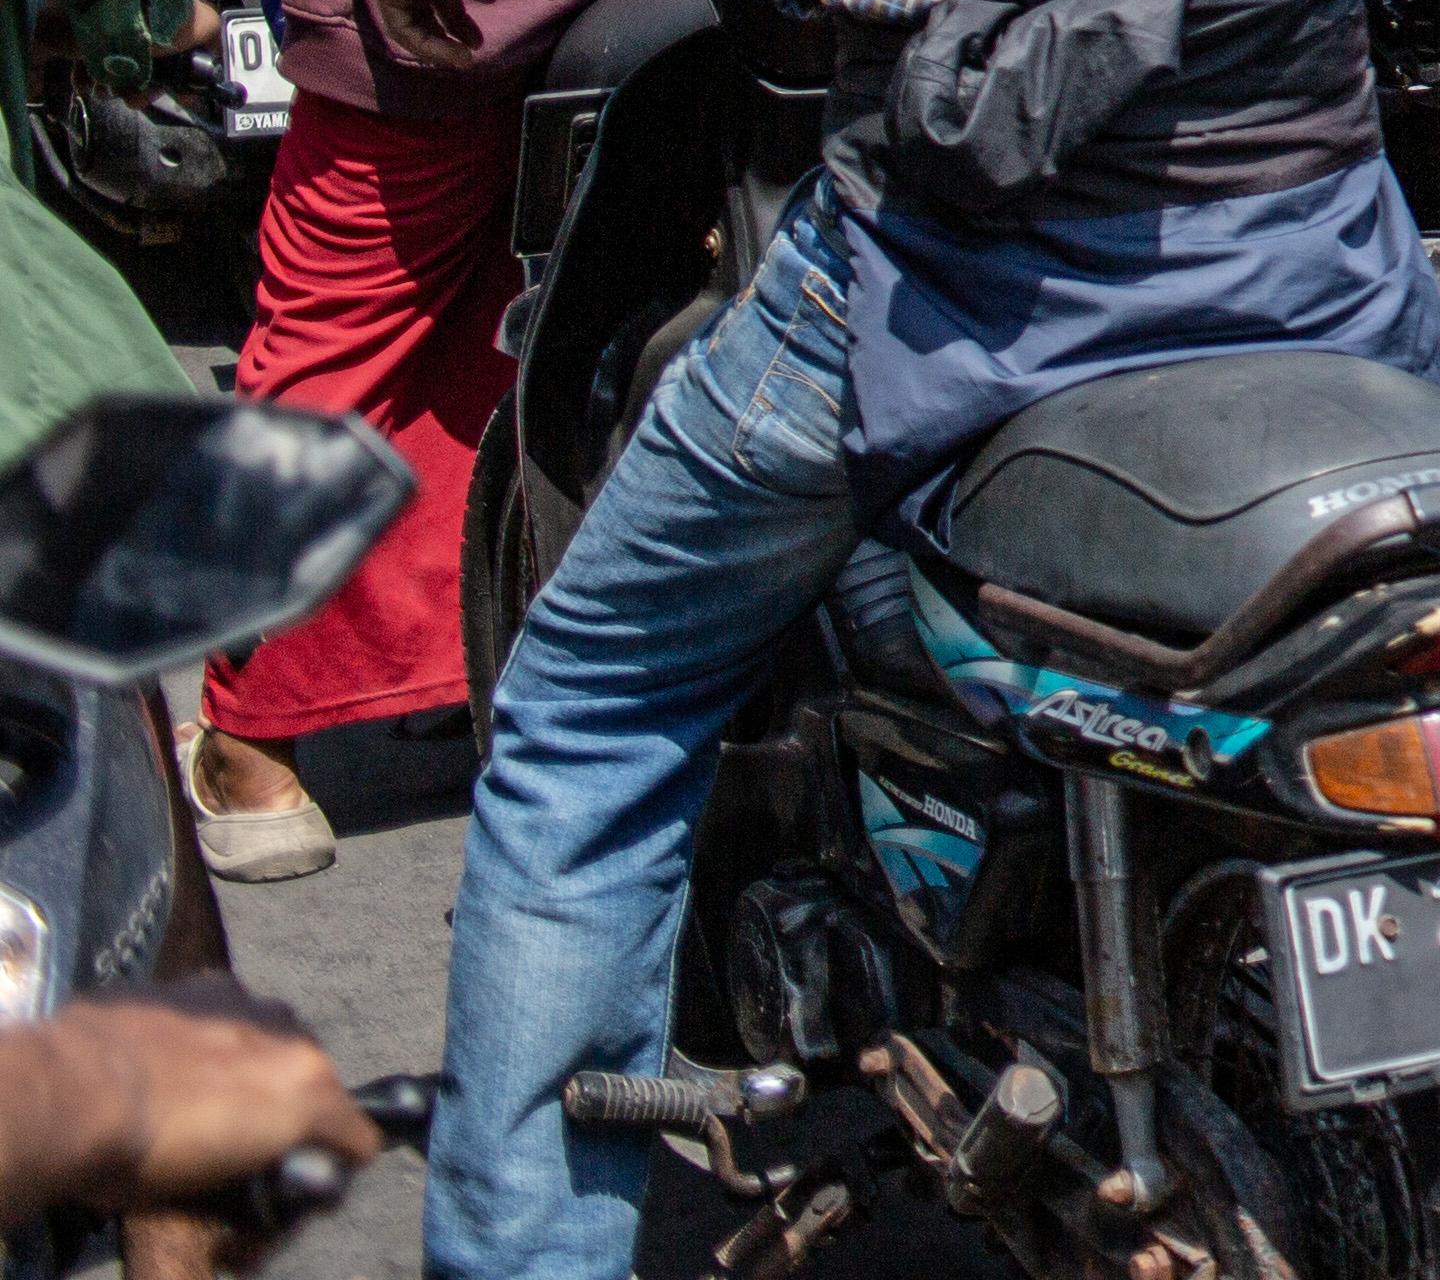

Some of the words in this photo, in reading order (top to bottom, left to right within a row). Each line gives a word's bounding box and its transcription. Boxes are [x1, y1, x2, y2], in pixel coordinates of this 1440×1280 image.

[1028, 689, 1169, 752] Astrea
[923, 794, 978, 842] HONDA
[1305, 886, 1396, 974] DK
